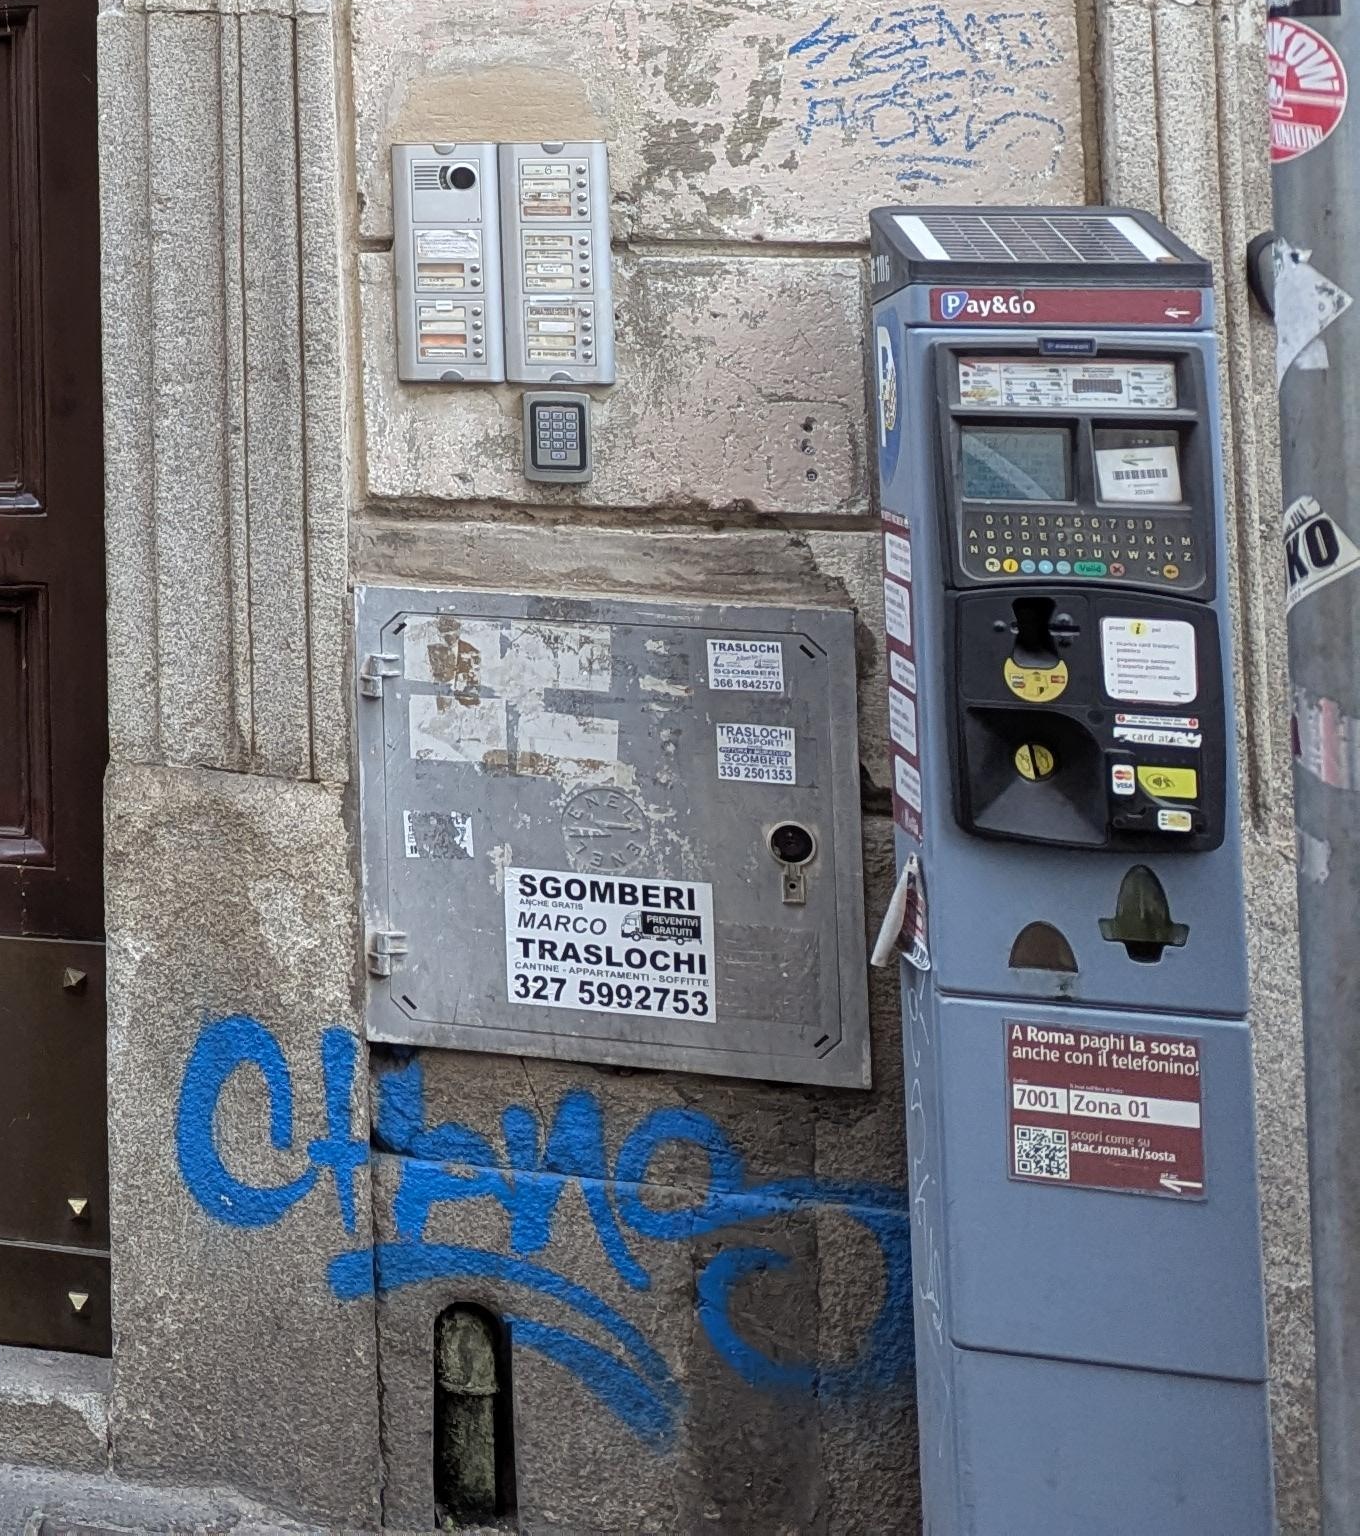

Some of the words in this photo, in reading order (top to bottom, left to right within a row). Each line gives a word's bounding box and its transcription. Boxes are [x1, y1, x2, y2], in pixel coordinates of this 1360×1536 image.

[946, 294, 1036, 315] Pay&Go
[986, 515, 993, 524] 0
[1004, 516, 1009, 525] 1
[1021, 516, 1028, 525] 2
[1039, 517, 1045, 526] 3
[1056, 518, 1063, 527] 4
[1074, 518, 1081, 527] 5
[1092, 519, 1099, 527] 6
[1109, 519, 1117, 528] 7
[1127, 520, 1134, 529] 8
[1145, 520, 1152, 529] 9
[969, 530, 977, 539] A
[987, 531, 994, 539] B
[1004, 531, 1012, 540] C
[1022, 532, 1030, 541] D
[1040, 533, 1047, 541] E
[1058, 533, 1064, 542] F
[1074, 534, 1083, 542] G
[1093, 535, 1101, 543] H
[1113, 535, 1116, 543] I
[1129, 536, 1135, 544] J
[1146, 536, 1154, 544] K
[1165, 537, 1171, 545] L
[1182, 537, 1191, 546] M
[971, 545, 978, 553] N
[988, 546, 996, 554] O
[1006, 547, 1013, 555] P
[1023, 547, 1031, 556] Q
[1041, 548, 1048, 556] R
[1059, 548, 1066, 557] S
[1076, 549, 1083, 557] T
[1094, 550, 1101, 558] U
[1112, 550, 1120, 559] V
[1128, 551, 1139, 559] W
[1147, 552, 1155, 560] X
[1166, 552, 1173, 560] Y
[1184, 553, 1191, 561] Z
[711, 642, 779, 653] TRASLOCHI
[714, 668, 779, 676] SGOMBERI
[736, 680, 781, 690] 1842570
[718, 726, 791, 740] TRASLOCHI
[1132, 733, 1154, 743] card
[728, 737, 783, 747] TRASPORTI
[724, 754, 788, 765] SGOMBERI
[720, 766, 740, 777] 339
[744, 767, 792, 781] 2501353
[519, 874, 696, 911] SGOMBERI
[520, 898, 549, 907] ANCHE
[552, 901, 583, 910] GRATIS
[518, 912, 607, 935] MARCO
[647, 915, 699, 927] PREVENTIVI
[652, 925, 692, 937] GRATUITI
[516, 937, 706, 975] TRASLOCHI
[515, 961, 559, 973] CANTINE
[569, 967, 649, 982] APPARTAMENTI
[658, 975, 709, 987] SOFFITTE
[514, 974, 566, 1002] 327
[579, 980, 708, 1016] 5992753
[1012, 1025, 1023, 1040] A
[1027, 1026, 1075, 1046] Roma
[1080, 1035, 1125, 1056] paghi
[1130, 1037, 1145, 1052] la
[1151, 1041, 1196, 1058] sosta
[1013, 1046, 1059, 1062] anche
[1065, 1052, 1092, 1066] con
[1098, 1050, 1107, 1068] il
[1112, 1055, 1199, 1077] telefonino!
[1016, 1088, 1059, 1109] 7001
[1074, 1094, 1122, 1116] Zona
[1128, 1100, 1150, 1118] 01
[1071, 1131, 1102, 1145] scopri
[1106, 1133, 1135, 1145] come
[1138, 1136, 1150, 1148] su
[1071, 1142, 1176, 1162] atac.roma.it/sosta
